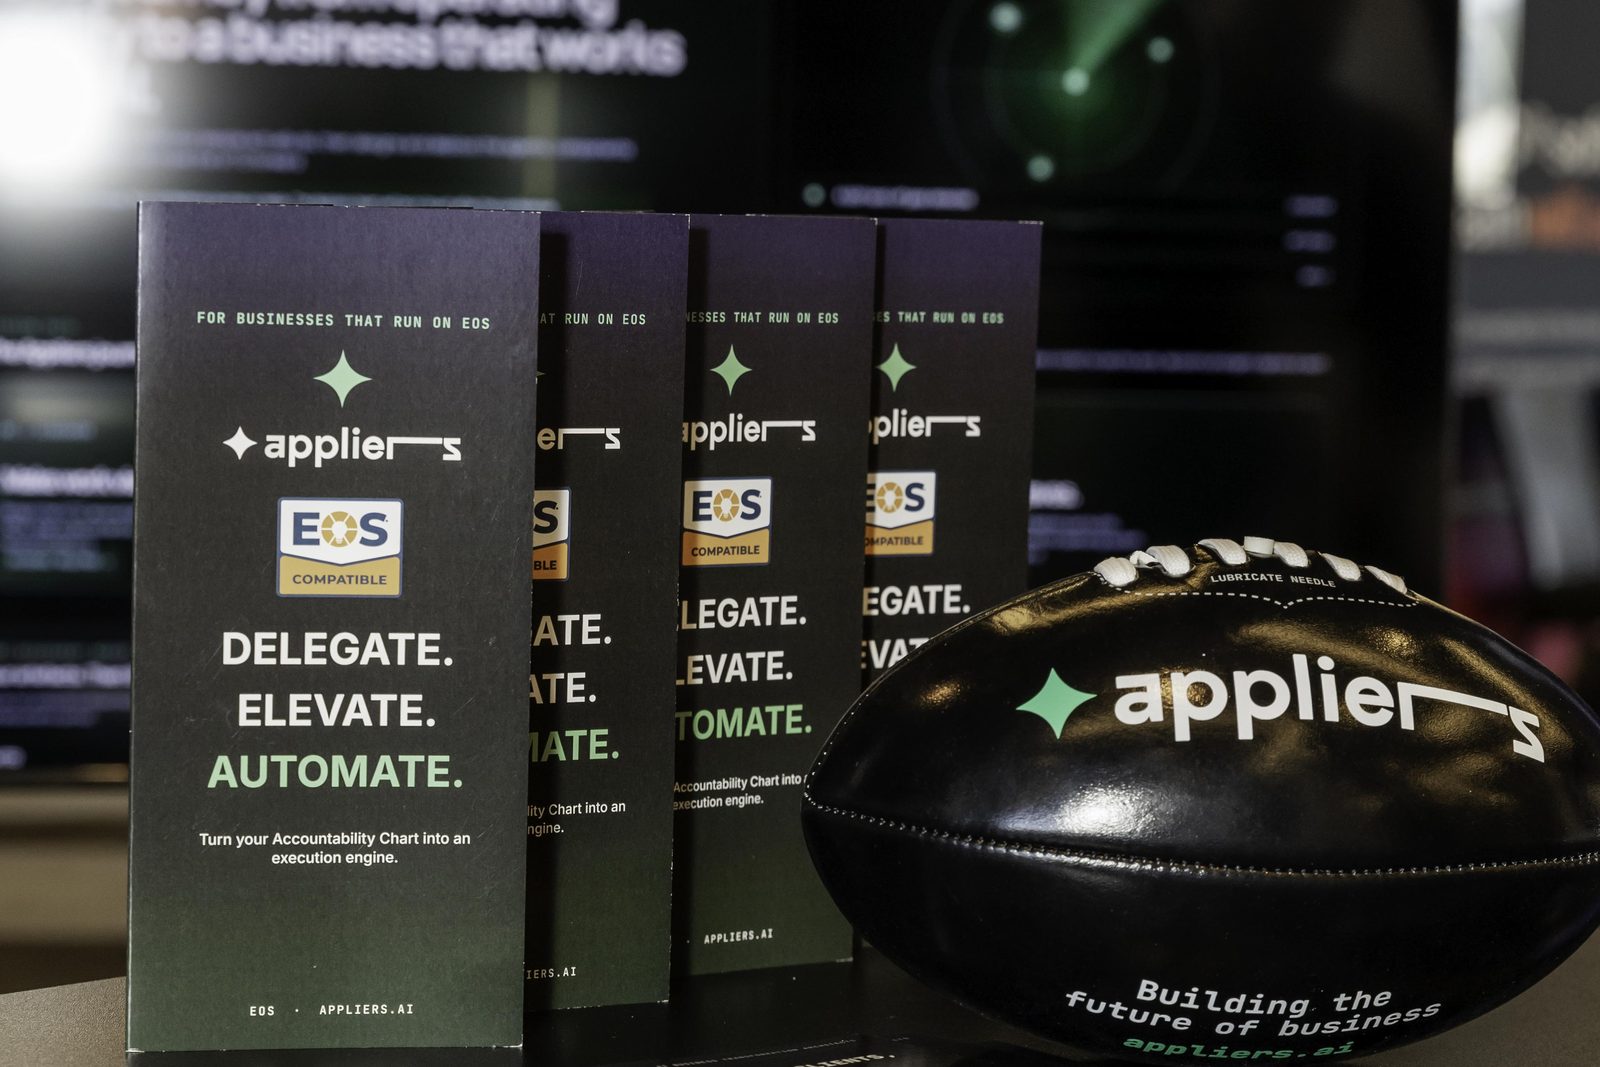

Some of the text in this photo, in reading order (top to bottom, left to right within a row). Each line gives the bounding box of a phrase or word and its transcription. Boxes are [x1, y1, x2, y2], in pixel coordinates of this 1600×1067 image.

[198, 312, 489, 329] FOR BUSINESSES THAT RUN ON EOS
[566, 313, 588, 324] RUN
[598, 314, 612, 324] ON
[623, 314, 645, 325] EOS
[734, 312, 761, 322] THAT
[769, 312, 789, 323] RUN
[797, 313, 810, 323] ON
[818, 313, 838, 323] EOS
[874, 311, 1003, 323] ES THAT RUN ON EOS
[868, 409, 981, 443] pliers
[692, 488, 762, 522] EOS
[293, 512, 388, 546] EOS
[691, 545, 761, 558] COMPATIBLE
[293, 575, 386, 584] COMPATIBLE
[1211, 573, 1336, 588] LUBRICATE NEEDLE
[223, 632, 452, 666] DELEGATE.
[239, 694, 435, 726] ELEVATE.
[208, 755, 462, 788] AUTOMATE.
[674, 777, 747, 792] Accountability
[750, 775, 779, 787] Chart
[781, 774, 802, 785] into
[550, 803, 582, 815] Chart
[586, 802, 607, 813] into
[611, 803, 625, 812] an
[673, 793, 763, 810] execution engine.
[199, 832, 470, 848] Turn your Accountability Chart into an
[272, 851, 398, 866] execution engine.
[704, 929, 772, 944] APPLIERS.AI
[1136, 978, 1392, 1018] Building the
[250, 1004, 413, 1016] EOS APPLIERS.AI
[1065, 990, 1442, 1037] future of business
[1122, 1036, 1354, 1060] appliers.ai
